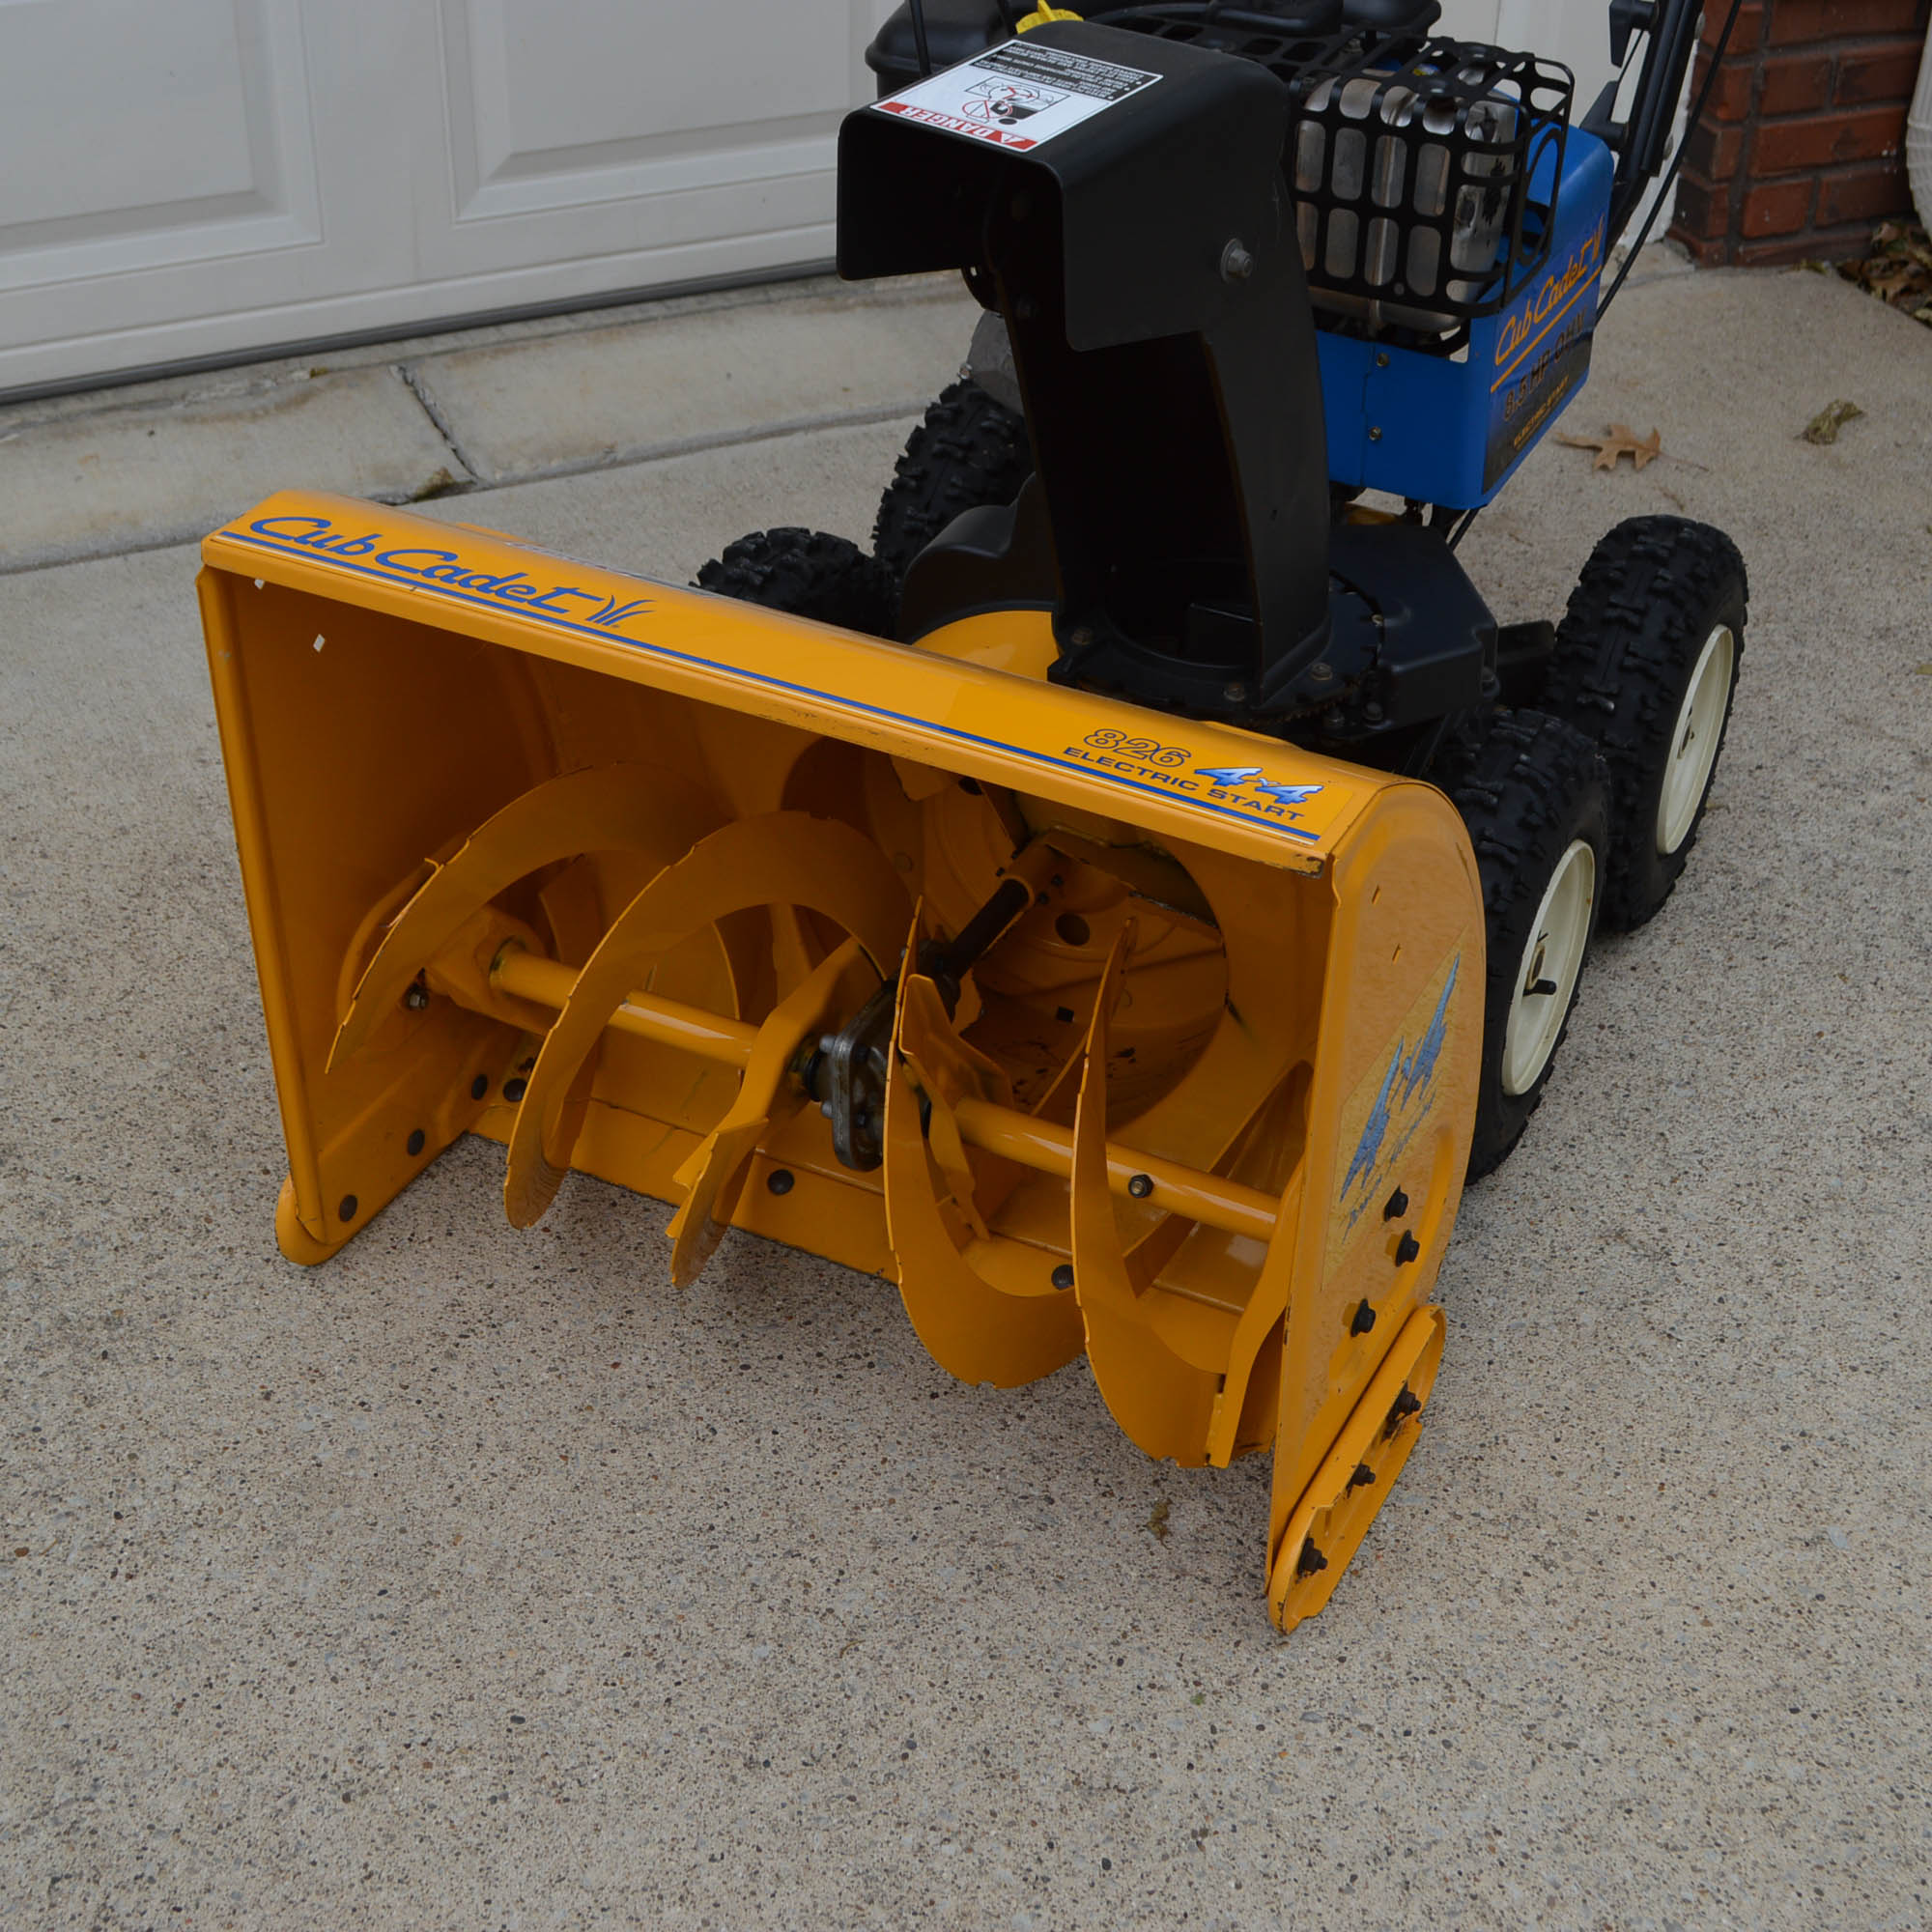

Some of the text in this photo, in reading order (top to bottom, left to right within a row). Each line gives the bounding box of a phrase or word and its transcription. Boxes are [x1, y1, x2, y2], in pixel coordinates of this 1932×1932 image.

[897, 106, 997, 141] DANGER
[1494, 238, 1593, 366] Cub Cadet
[249, 516, 606, 614] Cub Cadet
[1063, 747, 1305, 822] ELECTRIC START
[1083, 728, 1192, 768] 826
